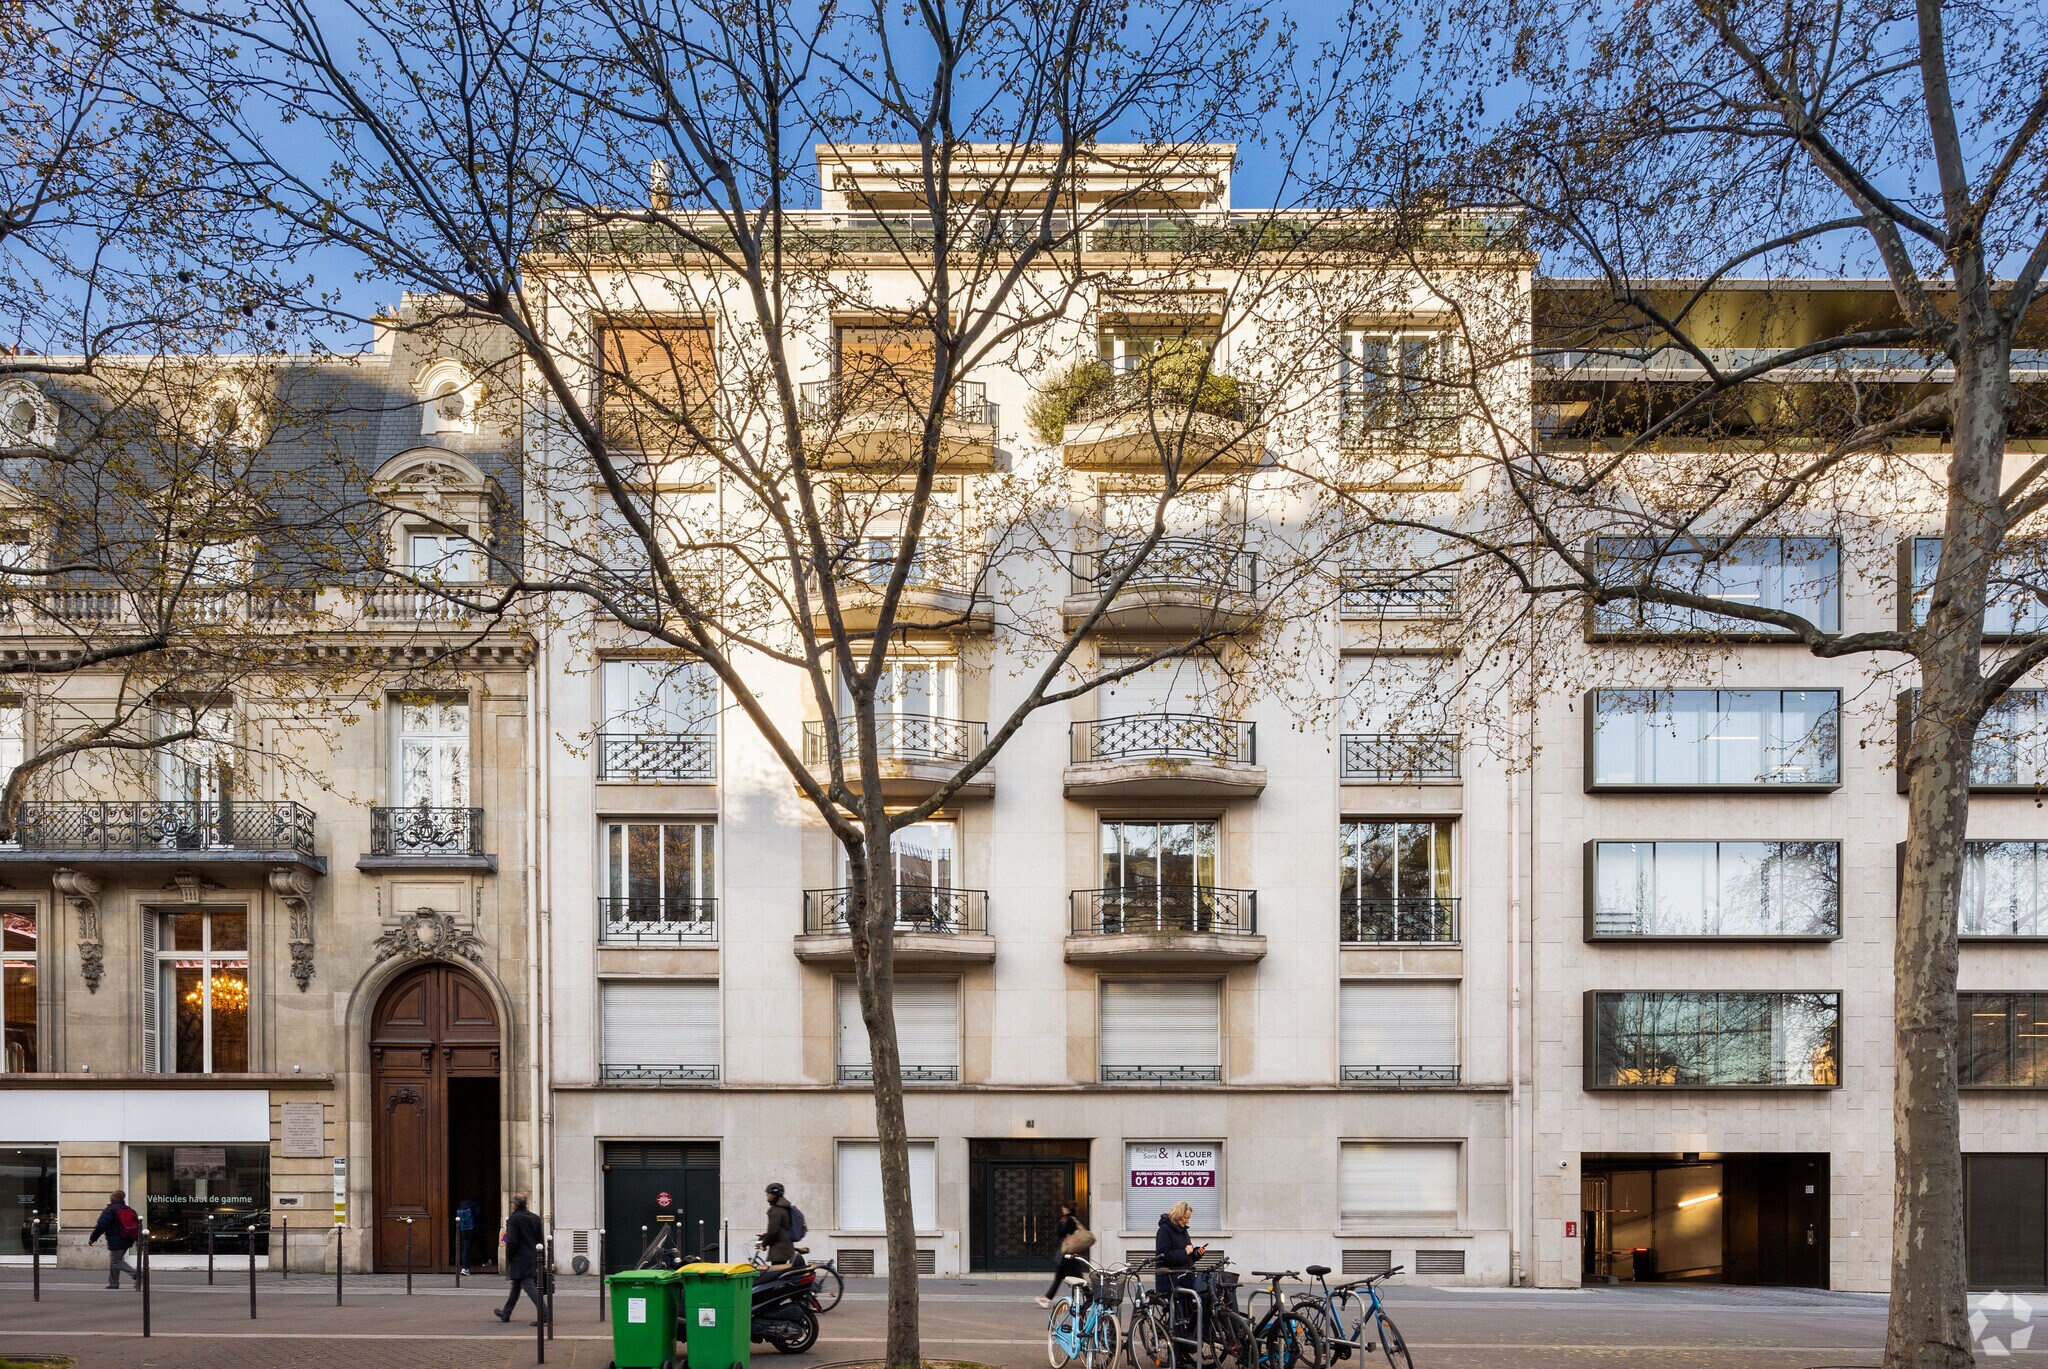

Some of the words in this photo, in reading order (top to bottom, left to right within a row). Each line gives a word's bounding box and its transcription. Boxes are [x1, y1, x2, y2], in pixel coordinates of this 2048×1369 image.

[1026, 1120, 1034, 1128] 81
[1158, 1147, 1168, 1159] &
[1176, 1149, 1182, 1158] À
[1135, 1177, 1148, 1186] 01
[1150, 1177, 1164, 1186] 43
[1166, 1177, 1179, 1186] 80
[1181, 1177, 1194, 1186] 40
[1197, 1177, 1210, 1186] 17
[147, 1195, 187, 1203] Véhicules
[188, 1195, 208, 1203] haut
[209, 1195, 219, 1203] de
[221, 1197, 252, 1205] gamme
